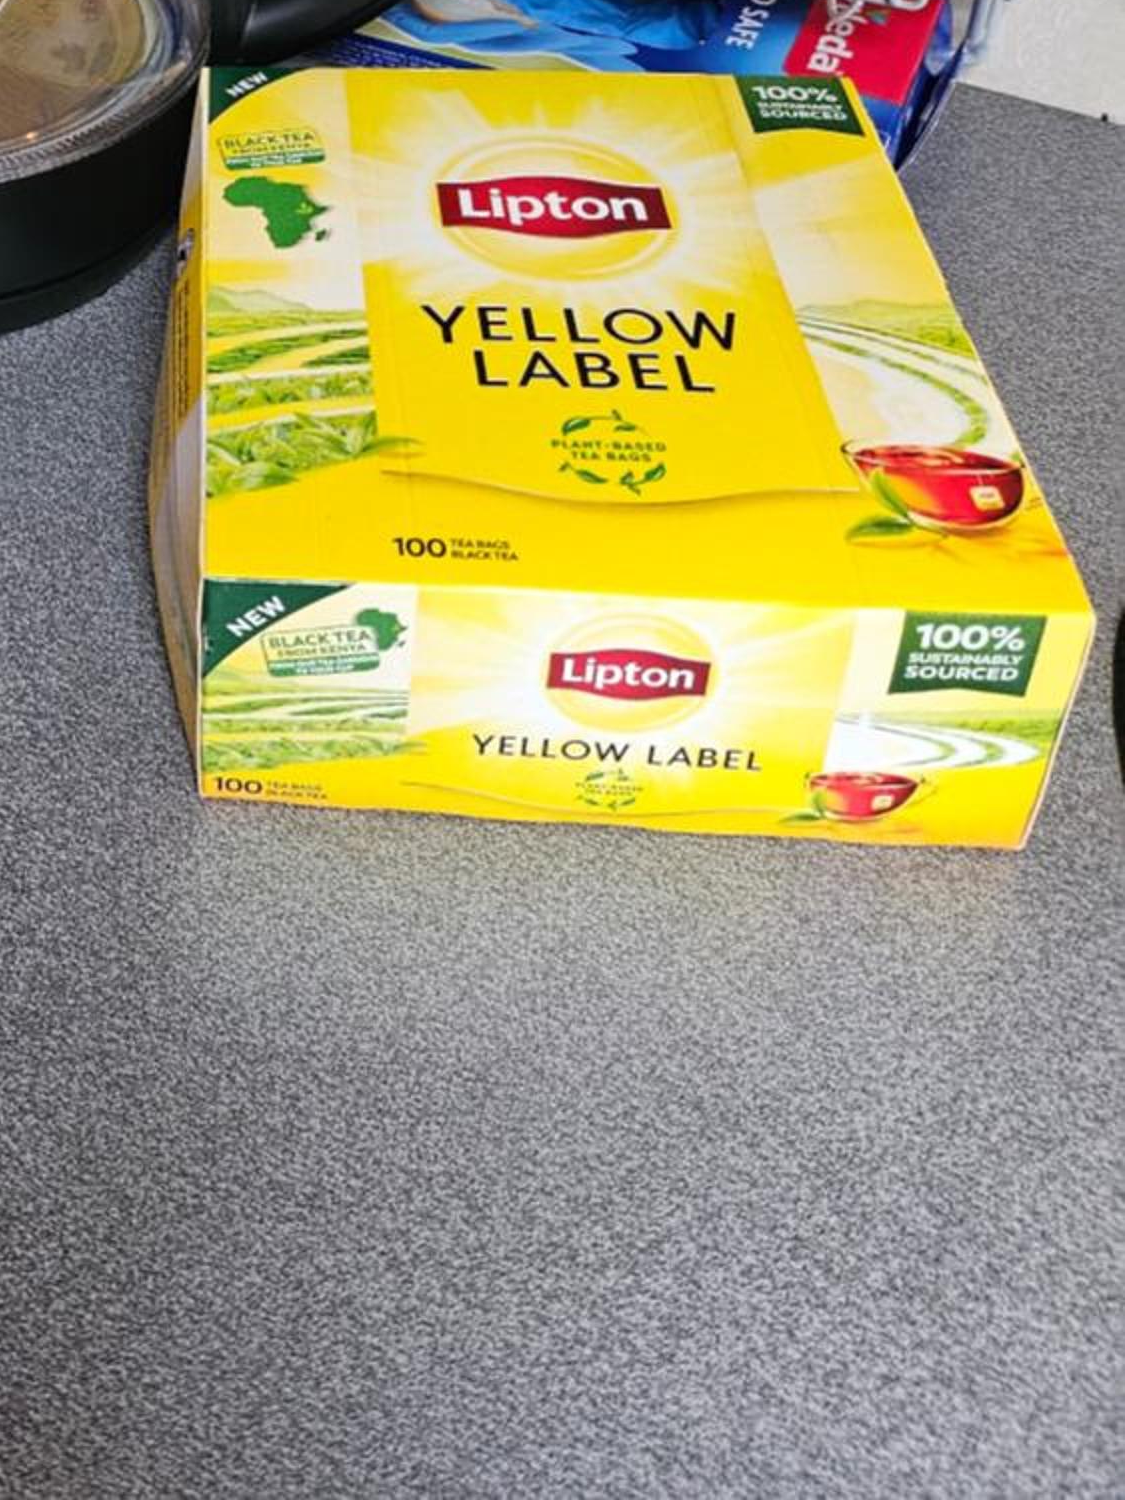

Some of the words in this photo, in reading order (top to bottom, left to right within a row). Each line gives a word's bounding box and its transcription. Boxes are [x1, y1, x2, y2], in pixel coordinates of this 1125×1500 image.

[725, 5, 771, 50] SAFE
[752, 86, 838, 102] 100%
[759, 109, 848, 120] SOURCED
[457, 187, 649, 226] Lipton
[420, 304, 736, 351] YELLOW
[472, 349, 716, 393] LABEL
[550, 439, 667, 452] PLANT-BASED
[571, 451, 600, 460] TEA
[606, 451, 652, 462] BAGS
[392, 537, 448, 559] 100
[450, 538, 474, 549] TEA
[451, 550, 492, 561] BLACK
[494, 551, 519, 561] TEA
[226, 595, 286, 637] NEW
[268, 633, 331, 649] BLACK
[333, 629, 372, 642] TEA
[915, 622, 1026, 651] 100%
[908, 651, 1023, 666] SUSTAINABLY
[561, 657, 695, 690] Lipton
[904, 665, 1020, 682] SOURCED
[472, 733, 630, 763] YELLOW
[646, 744, 763, 772] LABEL
[215, 776, 263, 795] 100
